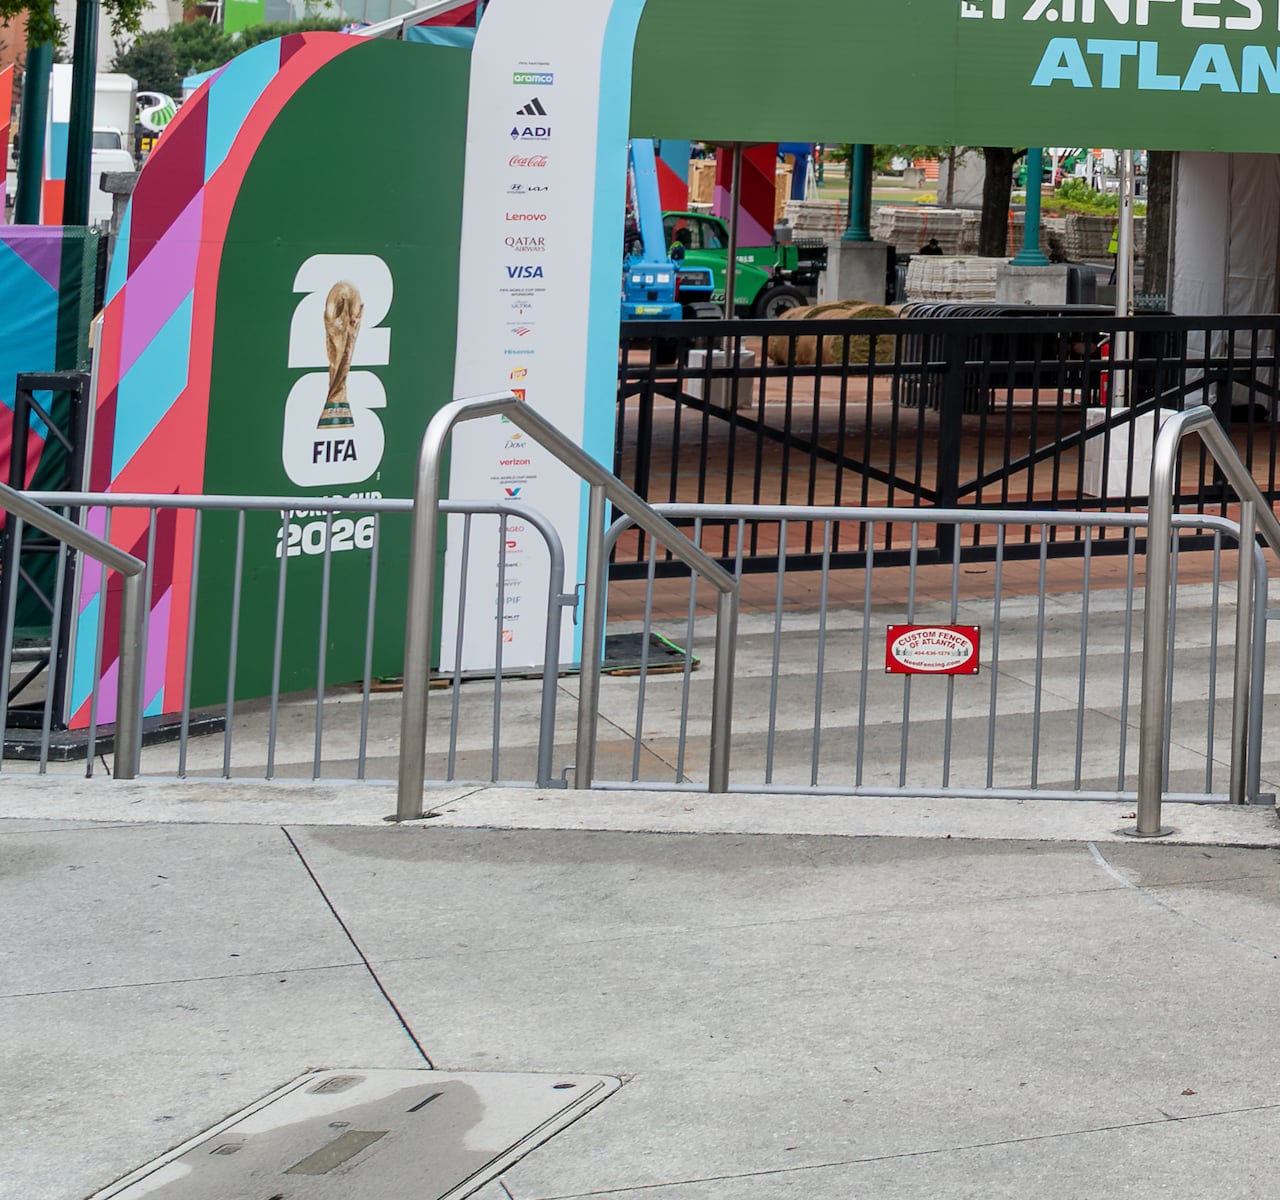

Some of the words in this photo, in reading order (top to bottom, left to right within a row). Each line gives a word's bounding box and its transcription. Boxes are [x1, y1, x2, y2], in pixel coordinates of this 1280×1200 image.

[514, 74, 553, 83] aramco
[521, 127, 551, 137] ADI
[505, 211, 547, 222] Lenovo
[504, 236, 545, 248] QATAR
[504, 265, 544, 279] VISA
[504, 440, 527, 449] Dove
[312, 439, 358, 464] FIFA
[499, 458, 531, 466] verizon
[275, 516, 377, 558] 2026
[898, 631, 936, 647] CUSTOM
[938, 632, 968, 648] FENCE
[909, 641, 920, 649] OF
[922, 638, 956, 650] ATLANTA
